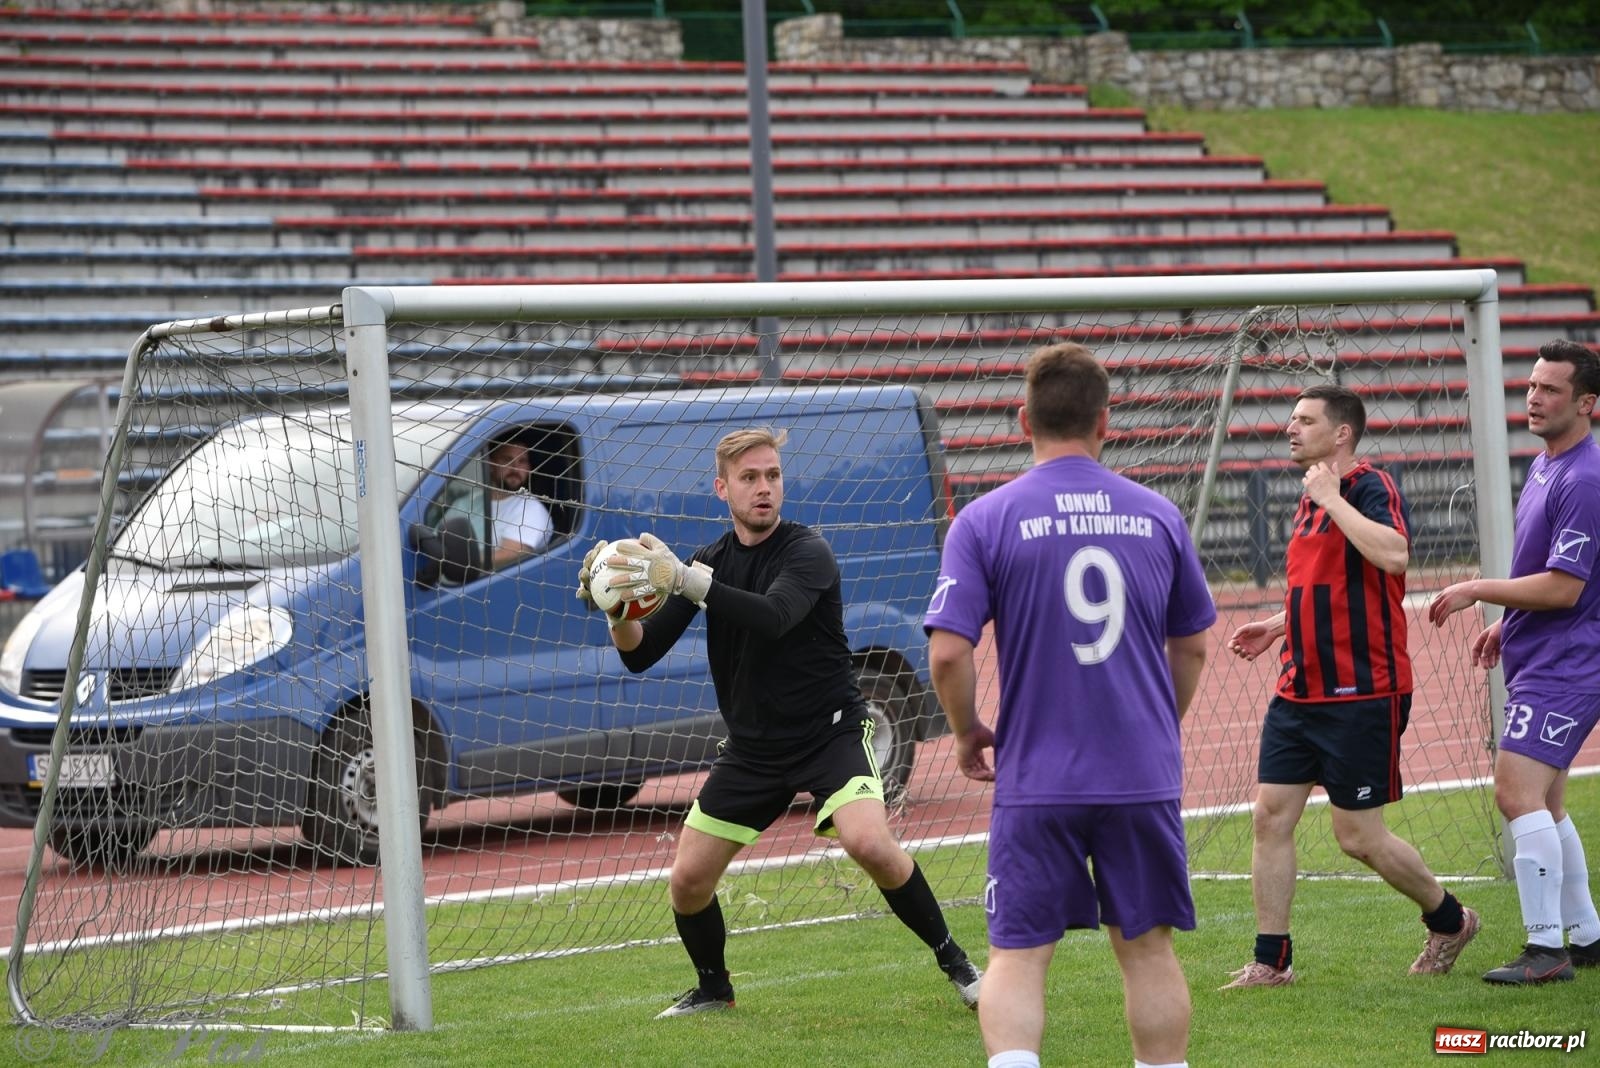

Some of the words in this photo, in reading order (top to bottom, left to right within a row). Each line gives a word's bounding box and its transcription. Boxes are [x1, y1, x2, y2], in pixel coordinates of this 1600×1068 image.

[1055, 490, 1111, 513] KONWÓJ
[1019, 516, 1052, 540] KWP
[1055, 519, 1067, 535] w
[1069, 515, 1152, 538] KATOWICACH
[1064, 546, 1126, 665] 9
